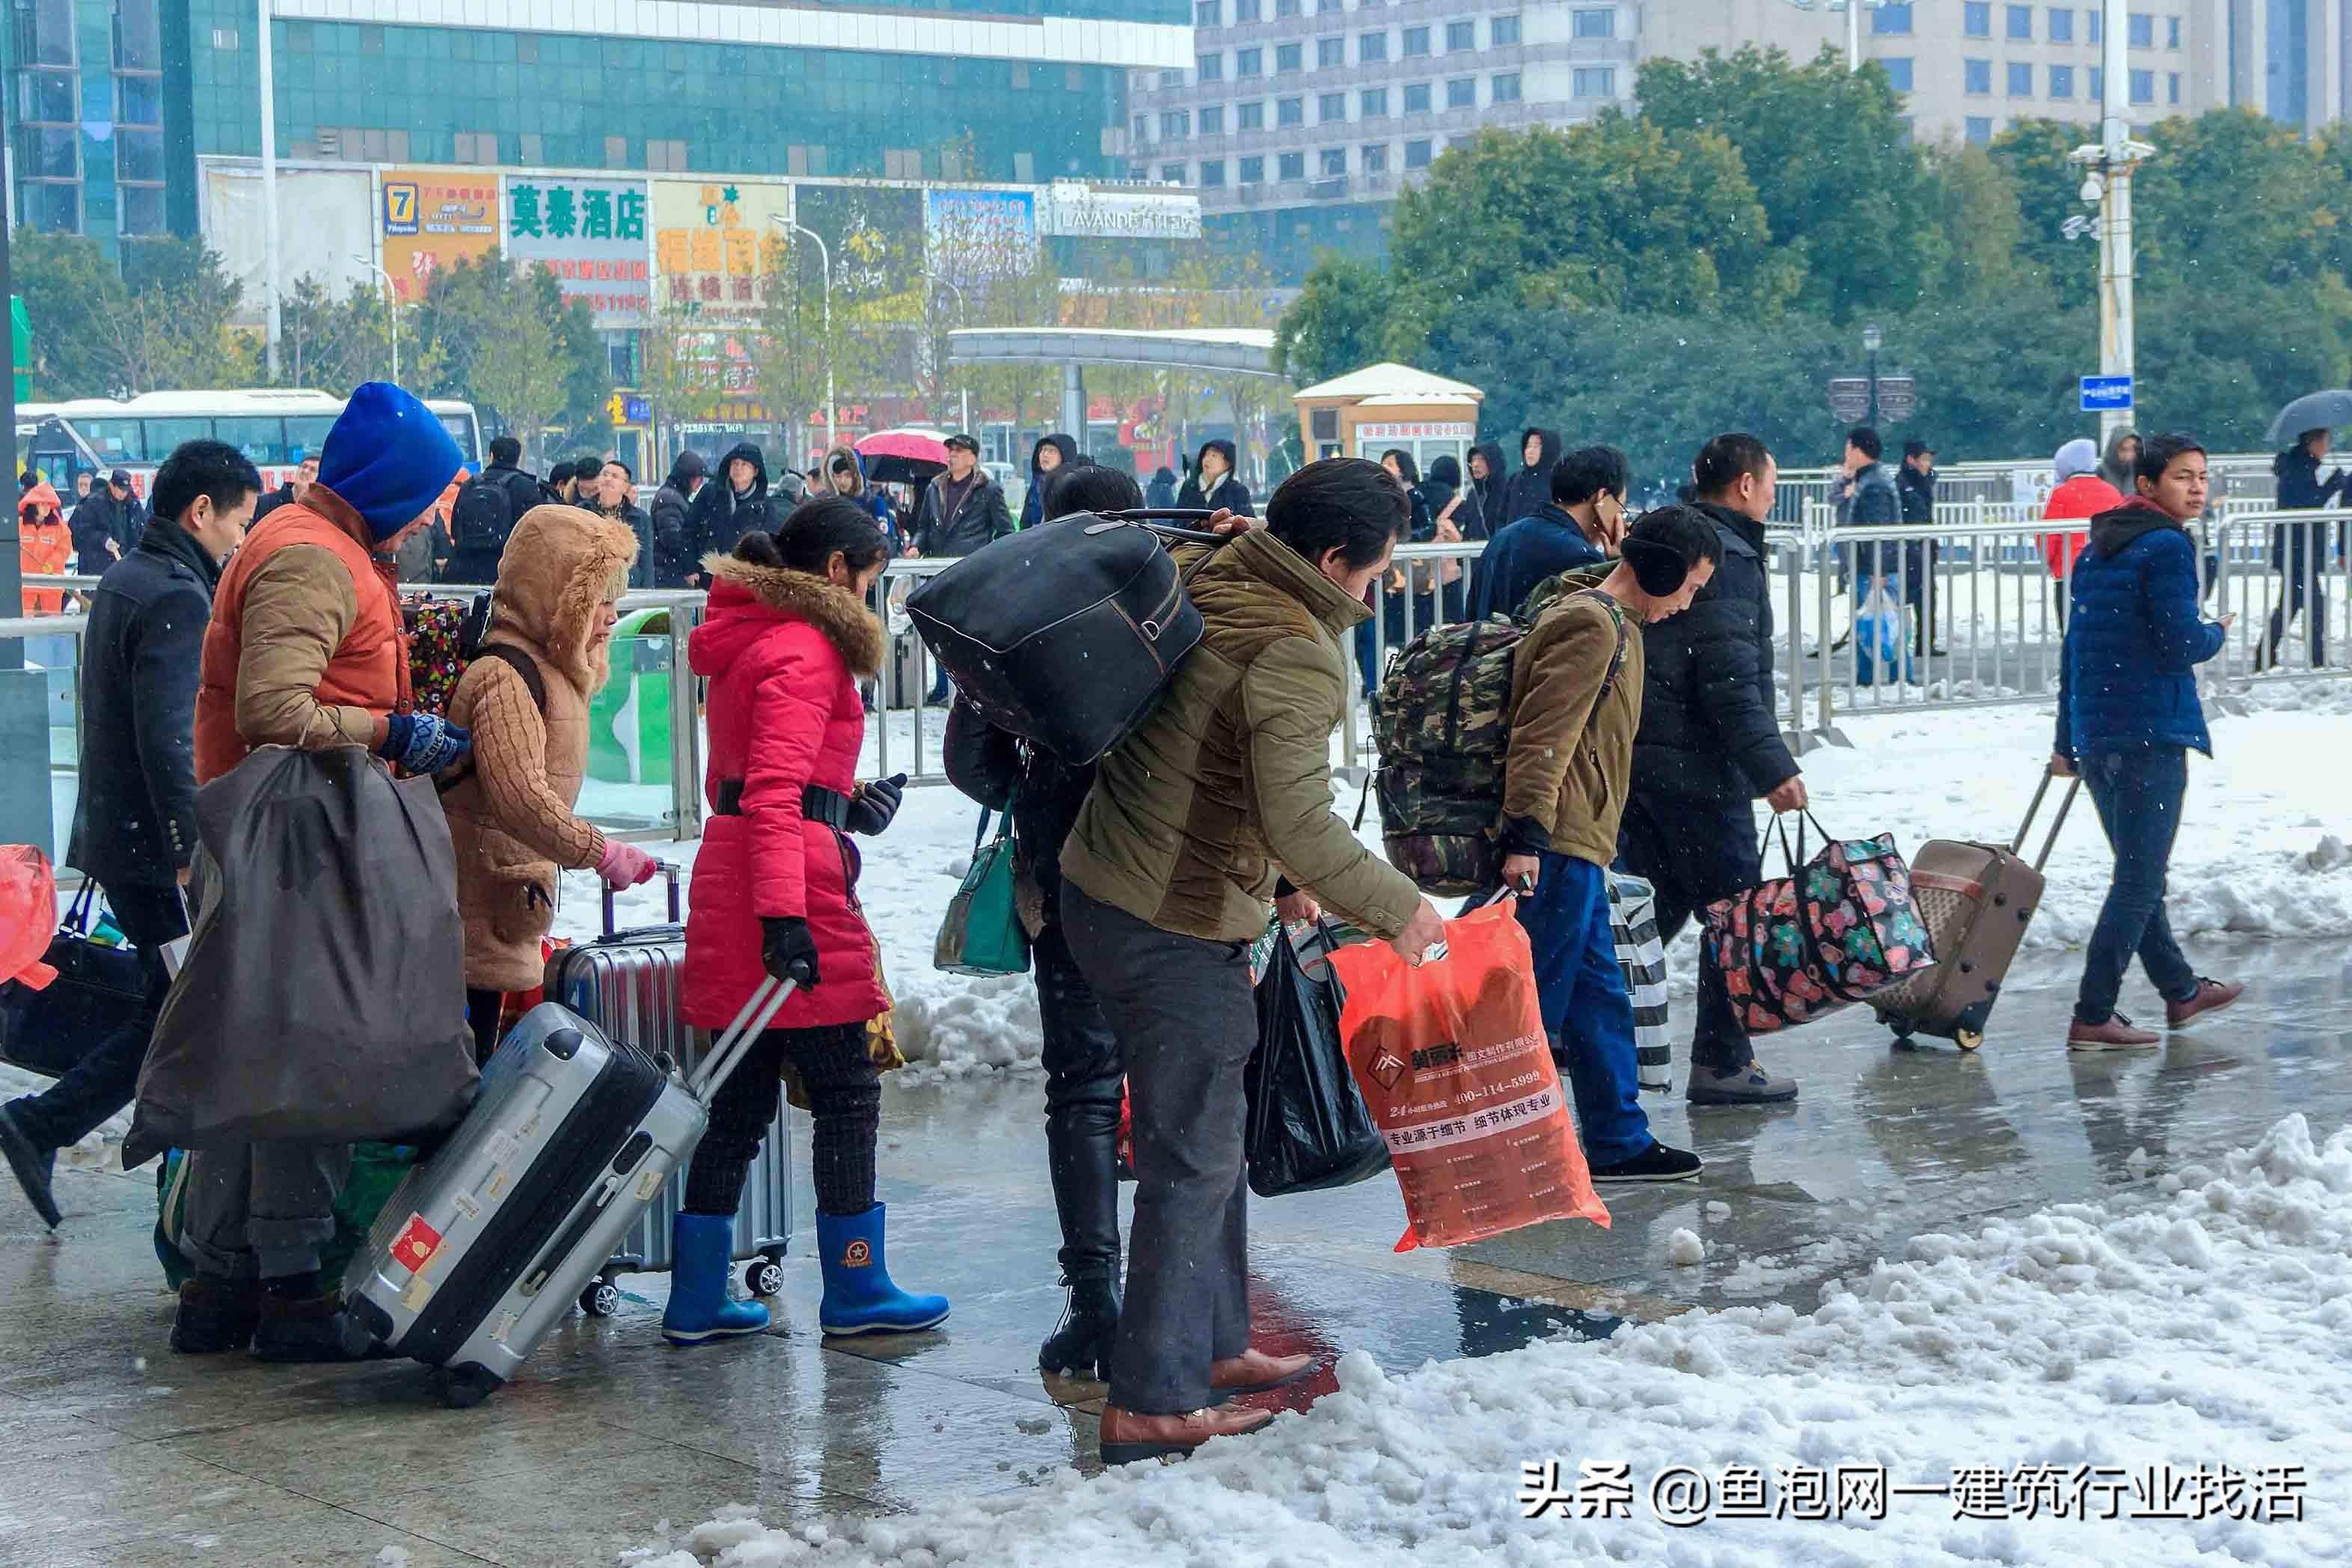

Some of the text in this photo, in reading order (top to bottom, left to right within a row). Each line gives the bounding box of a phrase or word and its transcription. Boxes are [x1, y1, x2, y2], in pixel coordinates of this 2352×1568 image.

[392, 190, 411, 217] 7
[509, 184, 646, 240] 莫泰酒店
[1454, 1071, 1540, 1104] 400-114-5999
[1390, 1093, 1551, 1145] 专业源于细节 细节体现专业
